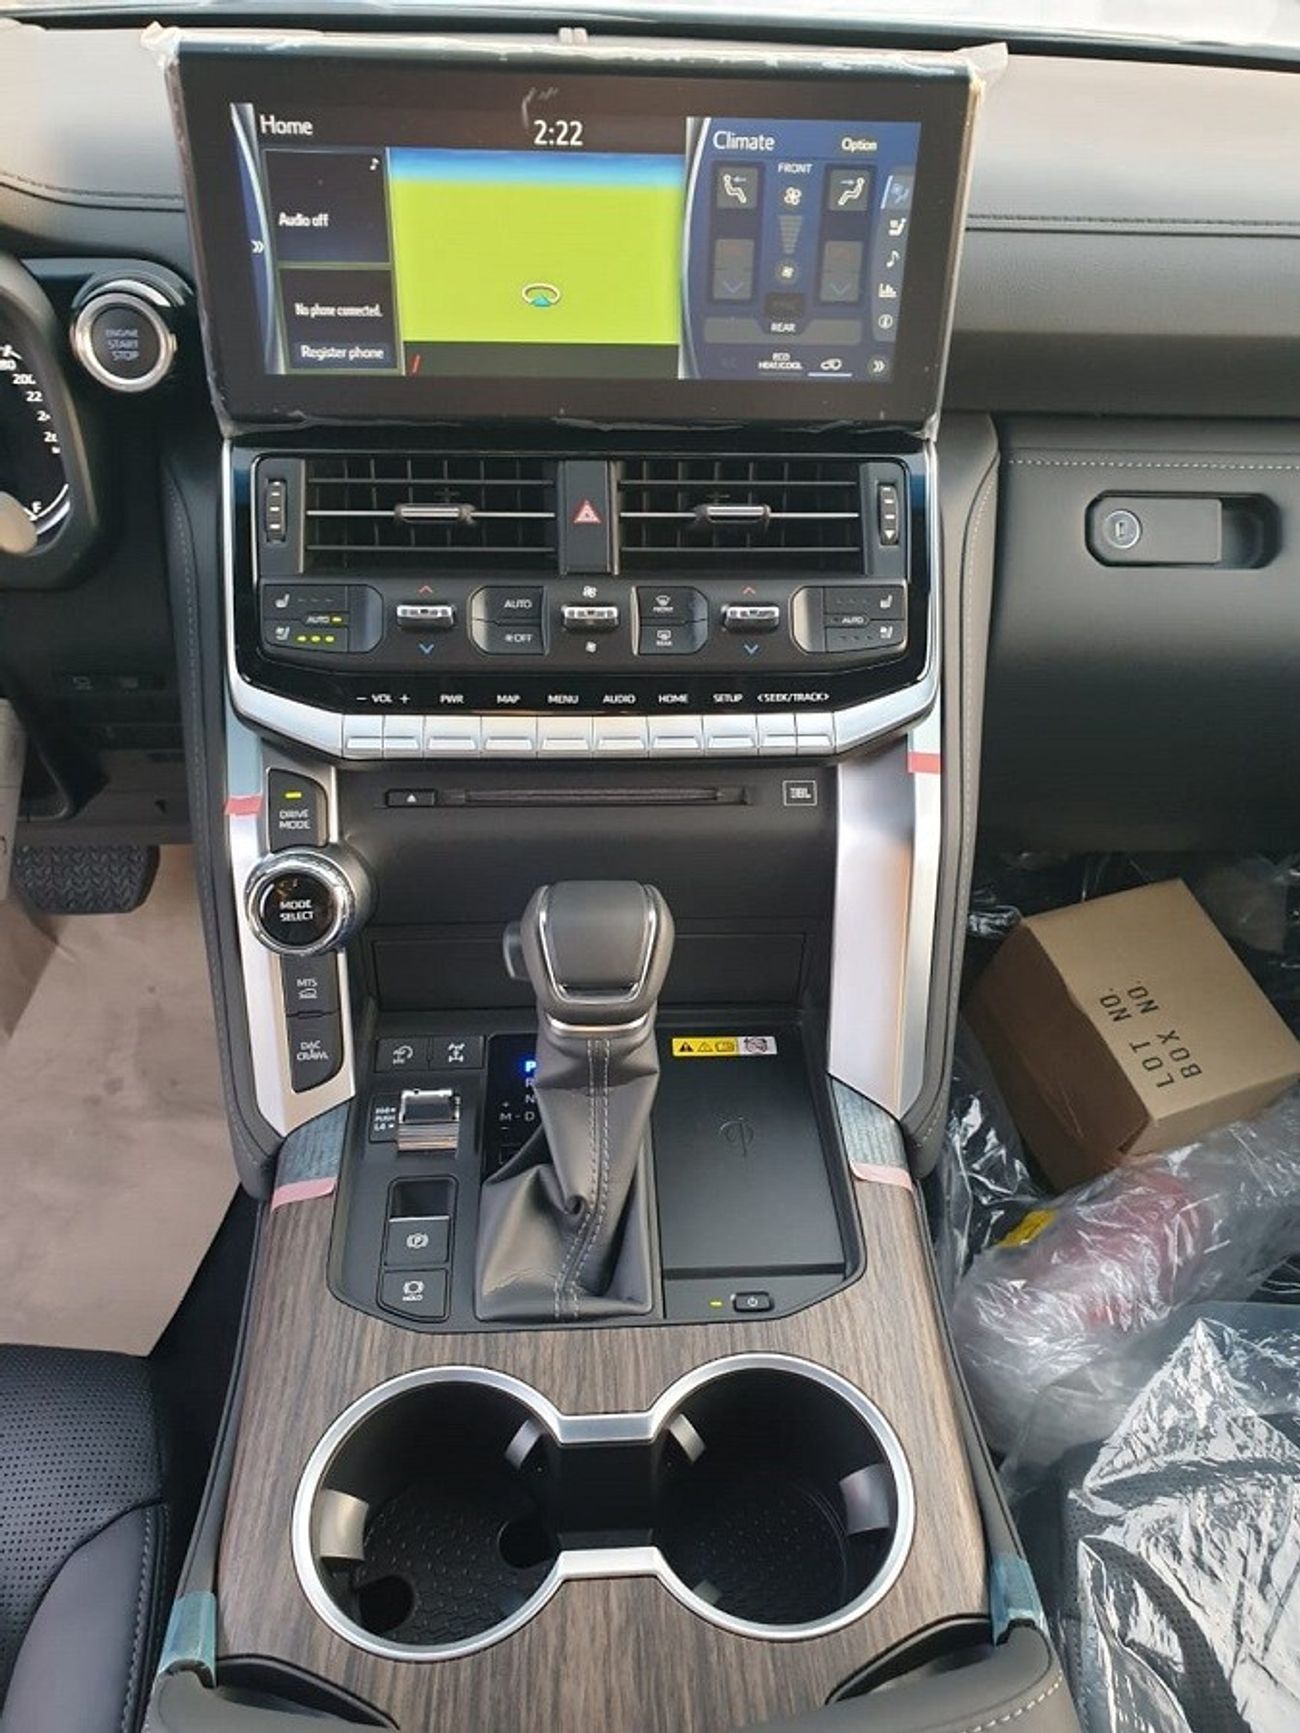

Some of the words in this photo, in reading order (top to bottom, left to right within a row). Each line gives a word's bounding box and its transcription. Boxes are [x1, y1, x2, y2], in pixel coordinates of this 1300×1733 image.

[259, 115, 314, 136] Home
[533, 119, 583, 146] 2:22
[712, 130, 776, 152] Climate
[841, 137, 878, 153] Option
[777, 162, 814, 174] FRONT
[278, 212, 311, 227] Audio
[312, 213, 329, 227] off
[295, 303, 309, 316] No
[310, 303, 336, 318] phone
[770, 322, 797, 333] REAR
[111, 350, 140, 361] STOP
[301, 345, 347, 361] Register
[348, 346, 384, 360] phone
[32, 501, 42, 514] F
[504, 599, 533, 609] AUTO
[306, 616, 330, 625] AUTO
[842, 616, 864, 624] AUTO
[514, 634, 533, 643] OFF
[371, 693, 393, 704] VOL
[440, 694, 464, 704] PWR
[497, 694, 521, 704] MAP
[548, 694, 579, 704] MENU
[602, 693, 637, 704] AUDIO
[658, 694, 689, 704] HOME
[713, 693, 743, 703] SETUP
[279, 809, 309, 820] DRIVE
[279, 820, 311, 830] MODE
[280, 900, 312, 910] MODE
[280, 911, 314, 922] SELECT
[296, 978, 318, 988] MTS
[300, 1041, 321, 1051] DAC
[1157, 1030, 1203, 1078] BOX
[525, 1060, 537, 1073] P
[1129, 1041, 1174, 1087] LOT
[500, 1112, 512, 1121] M
